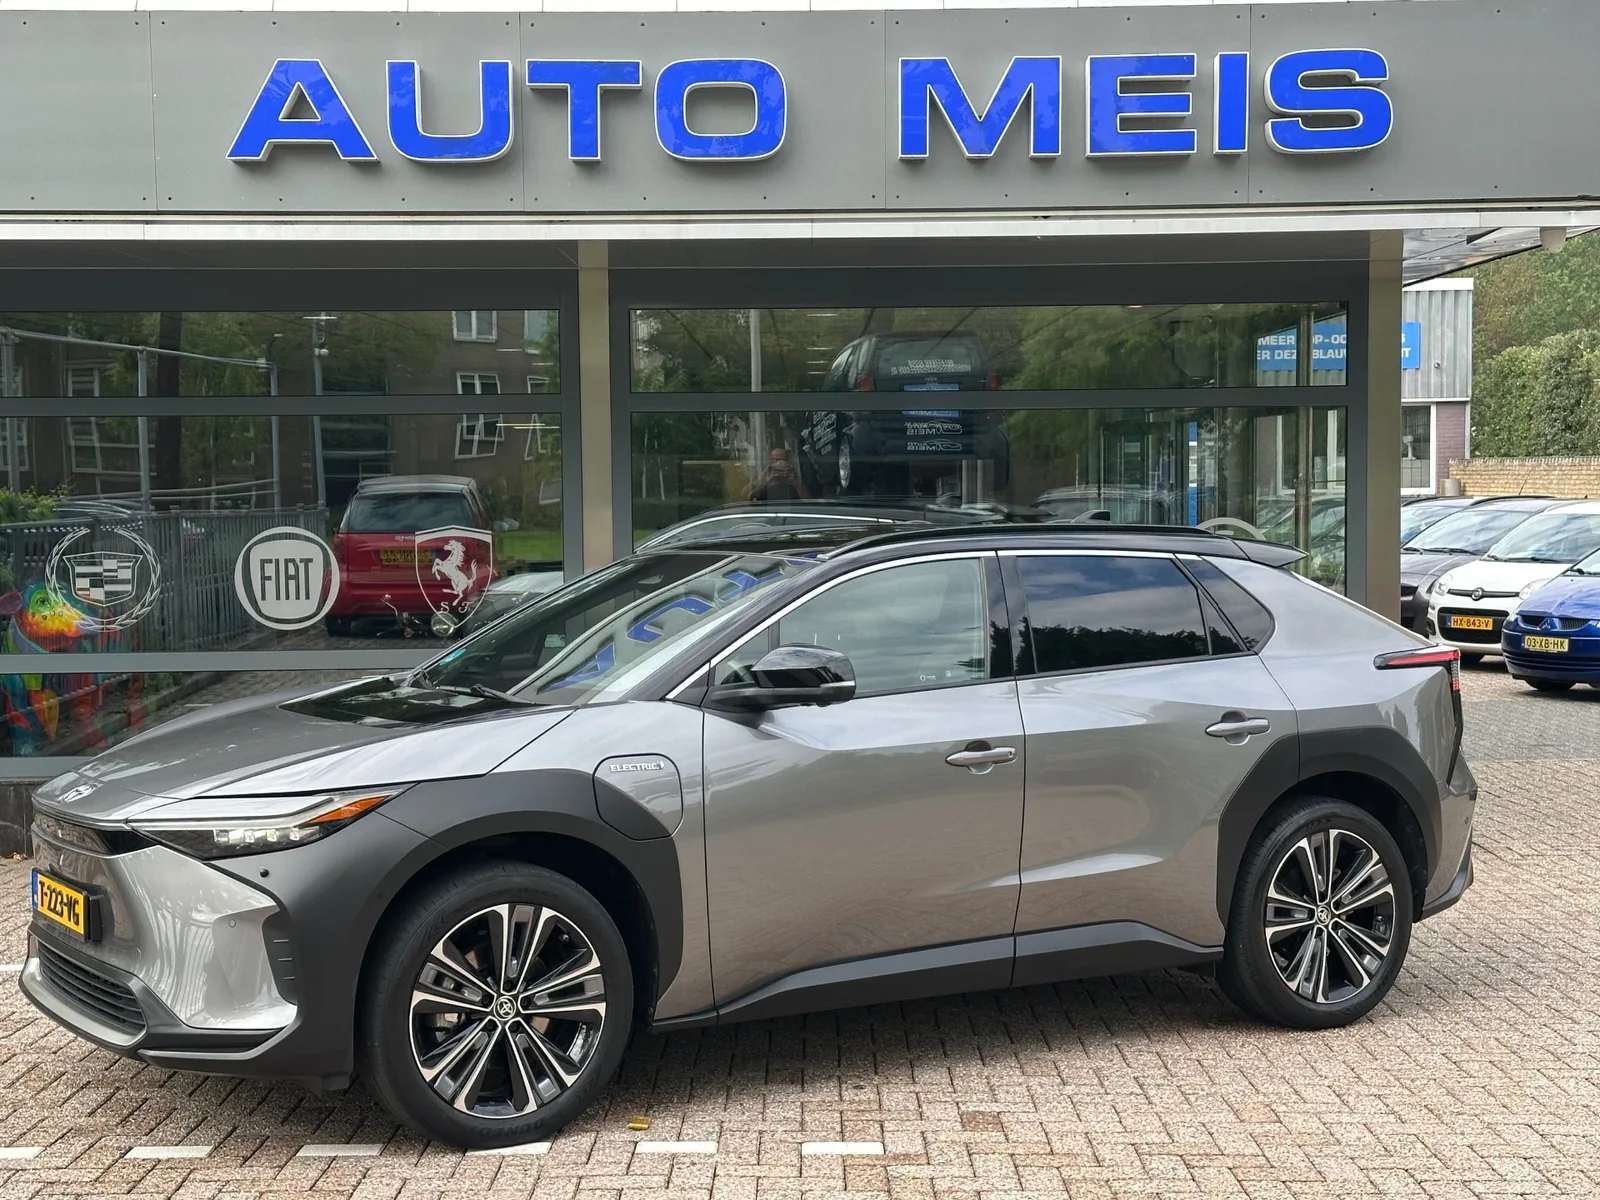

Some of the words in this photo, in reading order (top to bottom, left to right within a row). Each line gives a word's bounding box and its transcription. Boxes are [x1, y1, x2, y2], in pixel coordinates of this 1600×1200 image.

[225, 57, 788, 162] AUTO
[898, 48, 1394, 160] MEIS
[1258, 335, 1295, 345] MEER
[1274, 349, 1297, 360] DEZ
[259, 557, 314, 601] FIAT
[1452, 619, 1490, 629] HX-843-V
[1526, 637, 1566, 650] 03-XB-HK
[610, 763, 660, 772] ELECTRIC
[38, 879, 80, 926] T-223-VG
